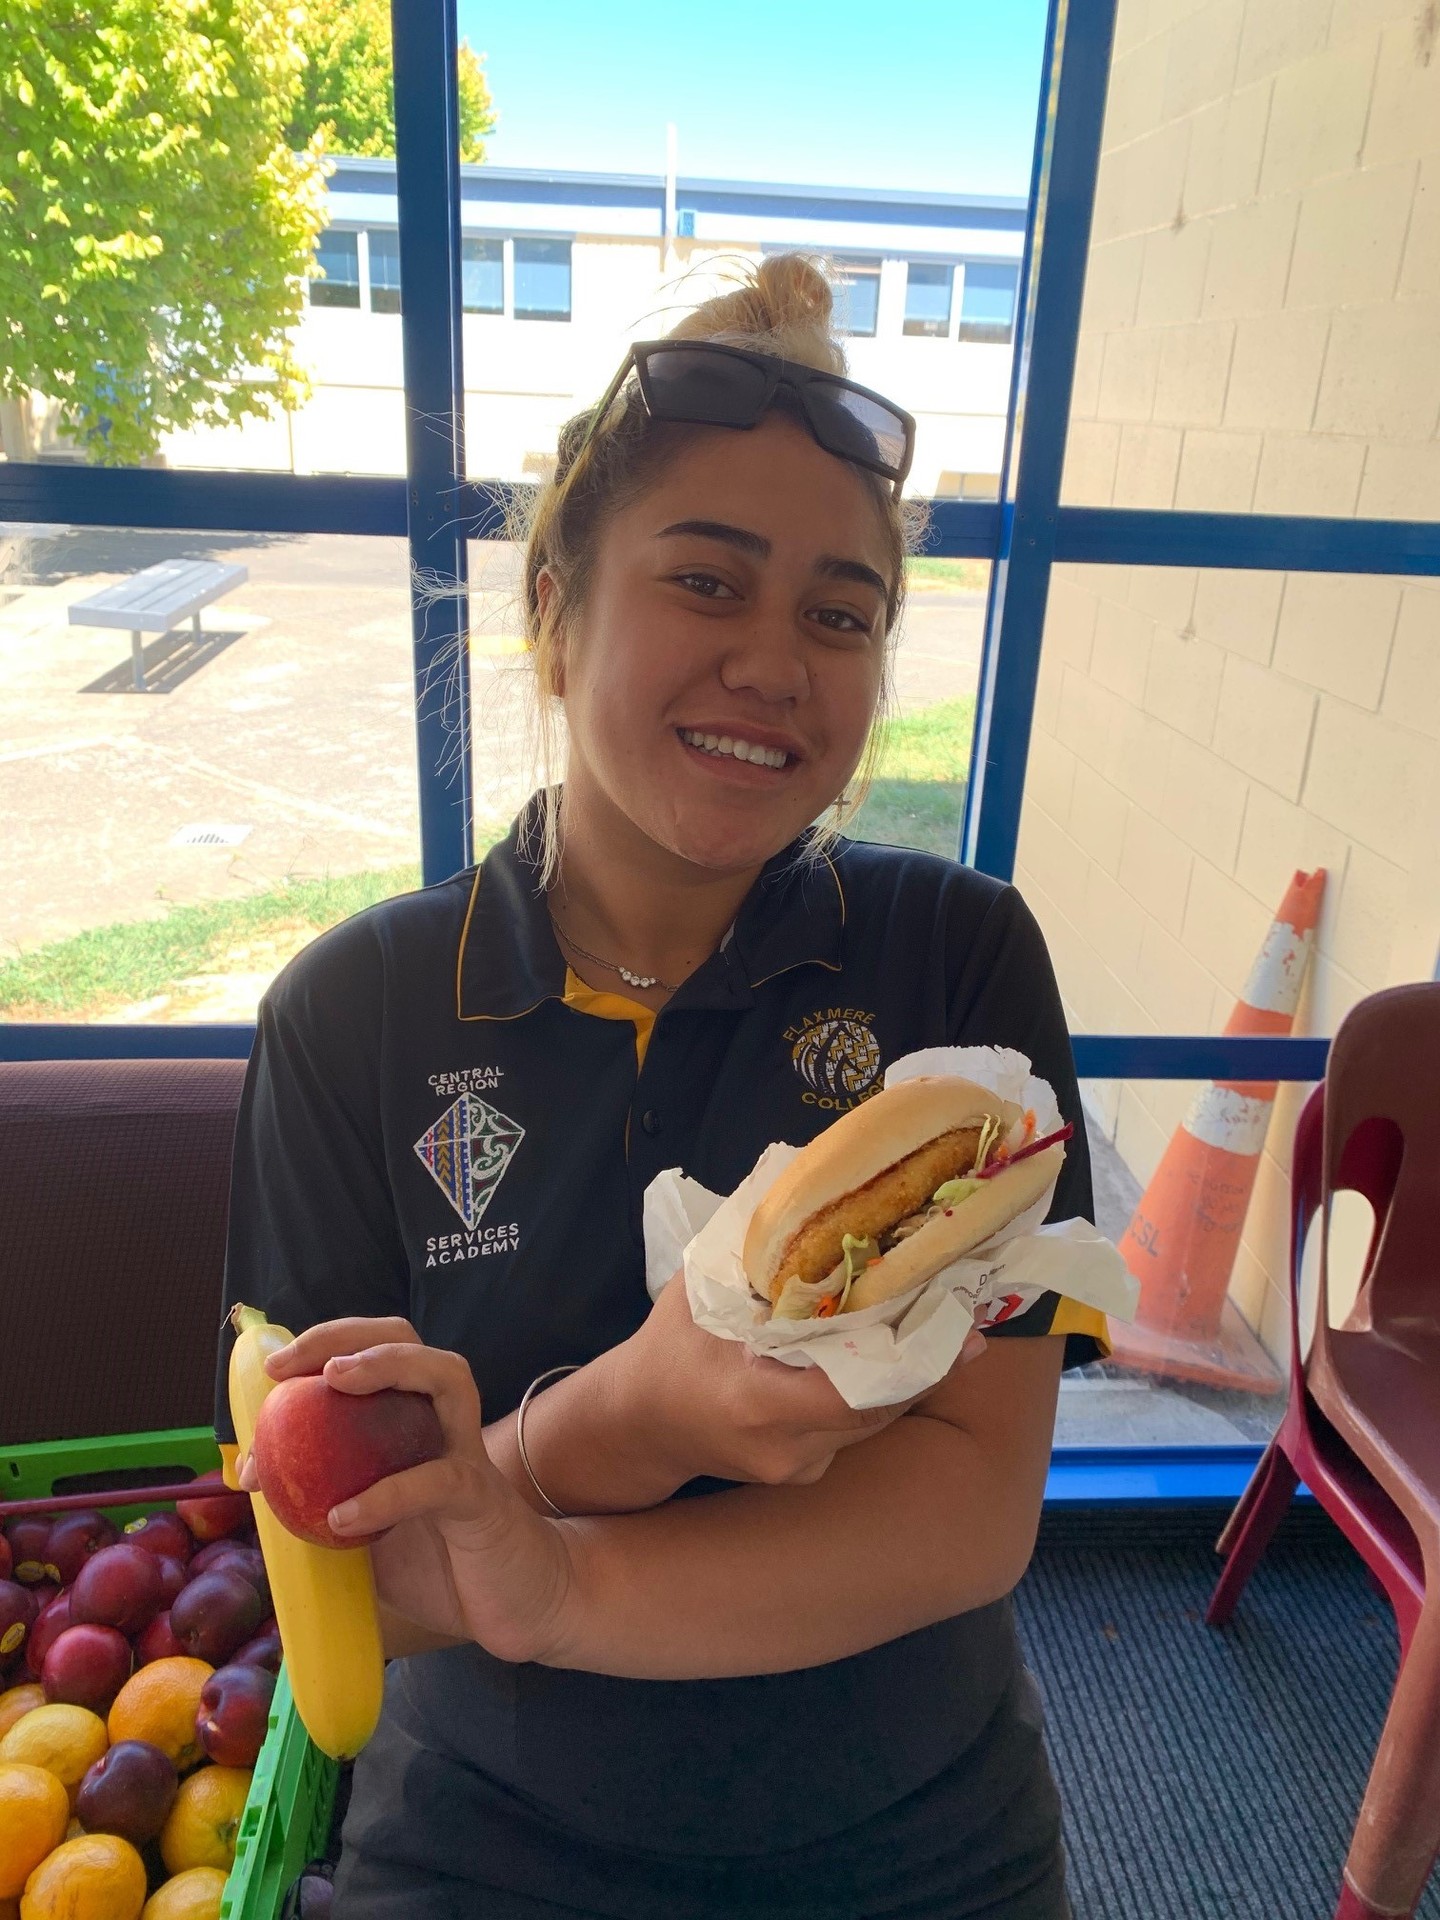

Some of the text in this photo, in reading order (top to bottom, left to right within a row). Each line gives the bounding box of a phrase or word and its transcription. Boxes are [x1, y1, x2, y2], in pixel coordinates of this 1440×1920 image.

[783, 1008, 876, 1041] FLAXMERE
[428, 1066, 504, 1086] CENTRAL
[435, 1077, 499, 1096] REGION
[426, 1223, 519, 1252] SERVICES
[425, 1237, 520, 1268] ACADEMY
